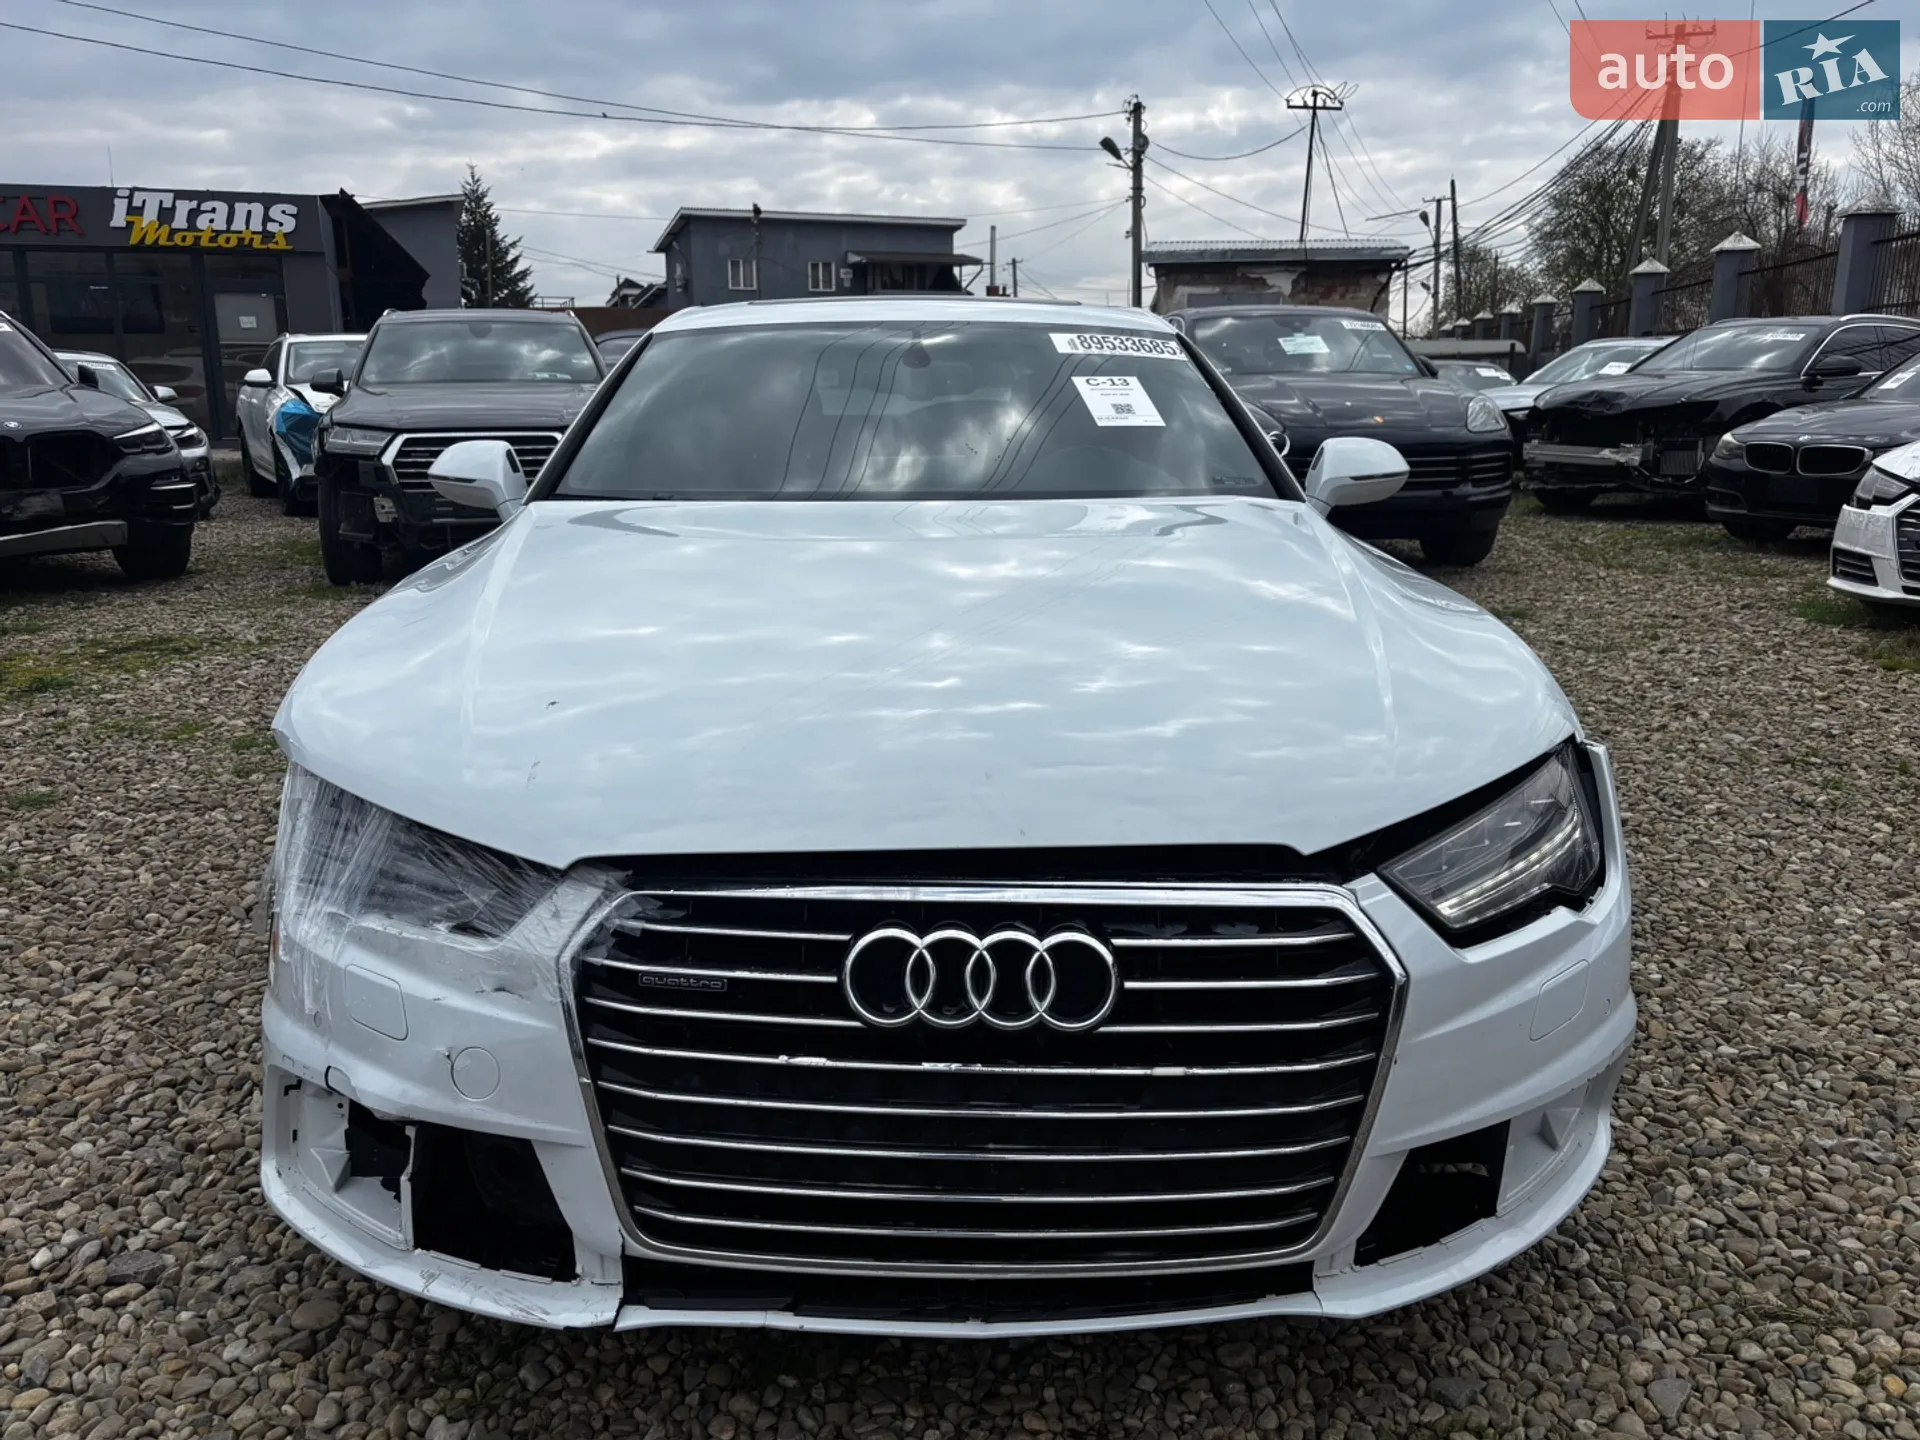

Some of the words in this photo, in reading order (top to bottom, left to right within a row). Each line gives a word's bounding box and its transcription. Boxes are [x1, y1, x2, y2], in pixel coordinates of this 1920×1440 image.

[109, 188, 298, 233] iTrans
[125, 215, 294, 250] Motors
[1076, 334, 1178, 356] 89533685
[1085, 377, 1131, 387] C-13
[642, 976, 723, 989] quattro
